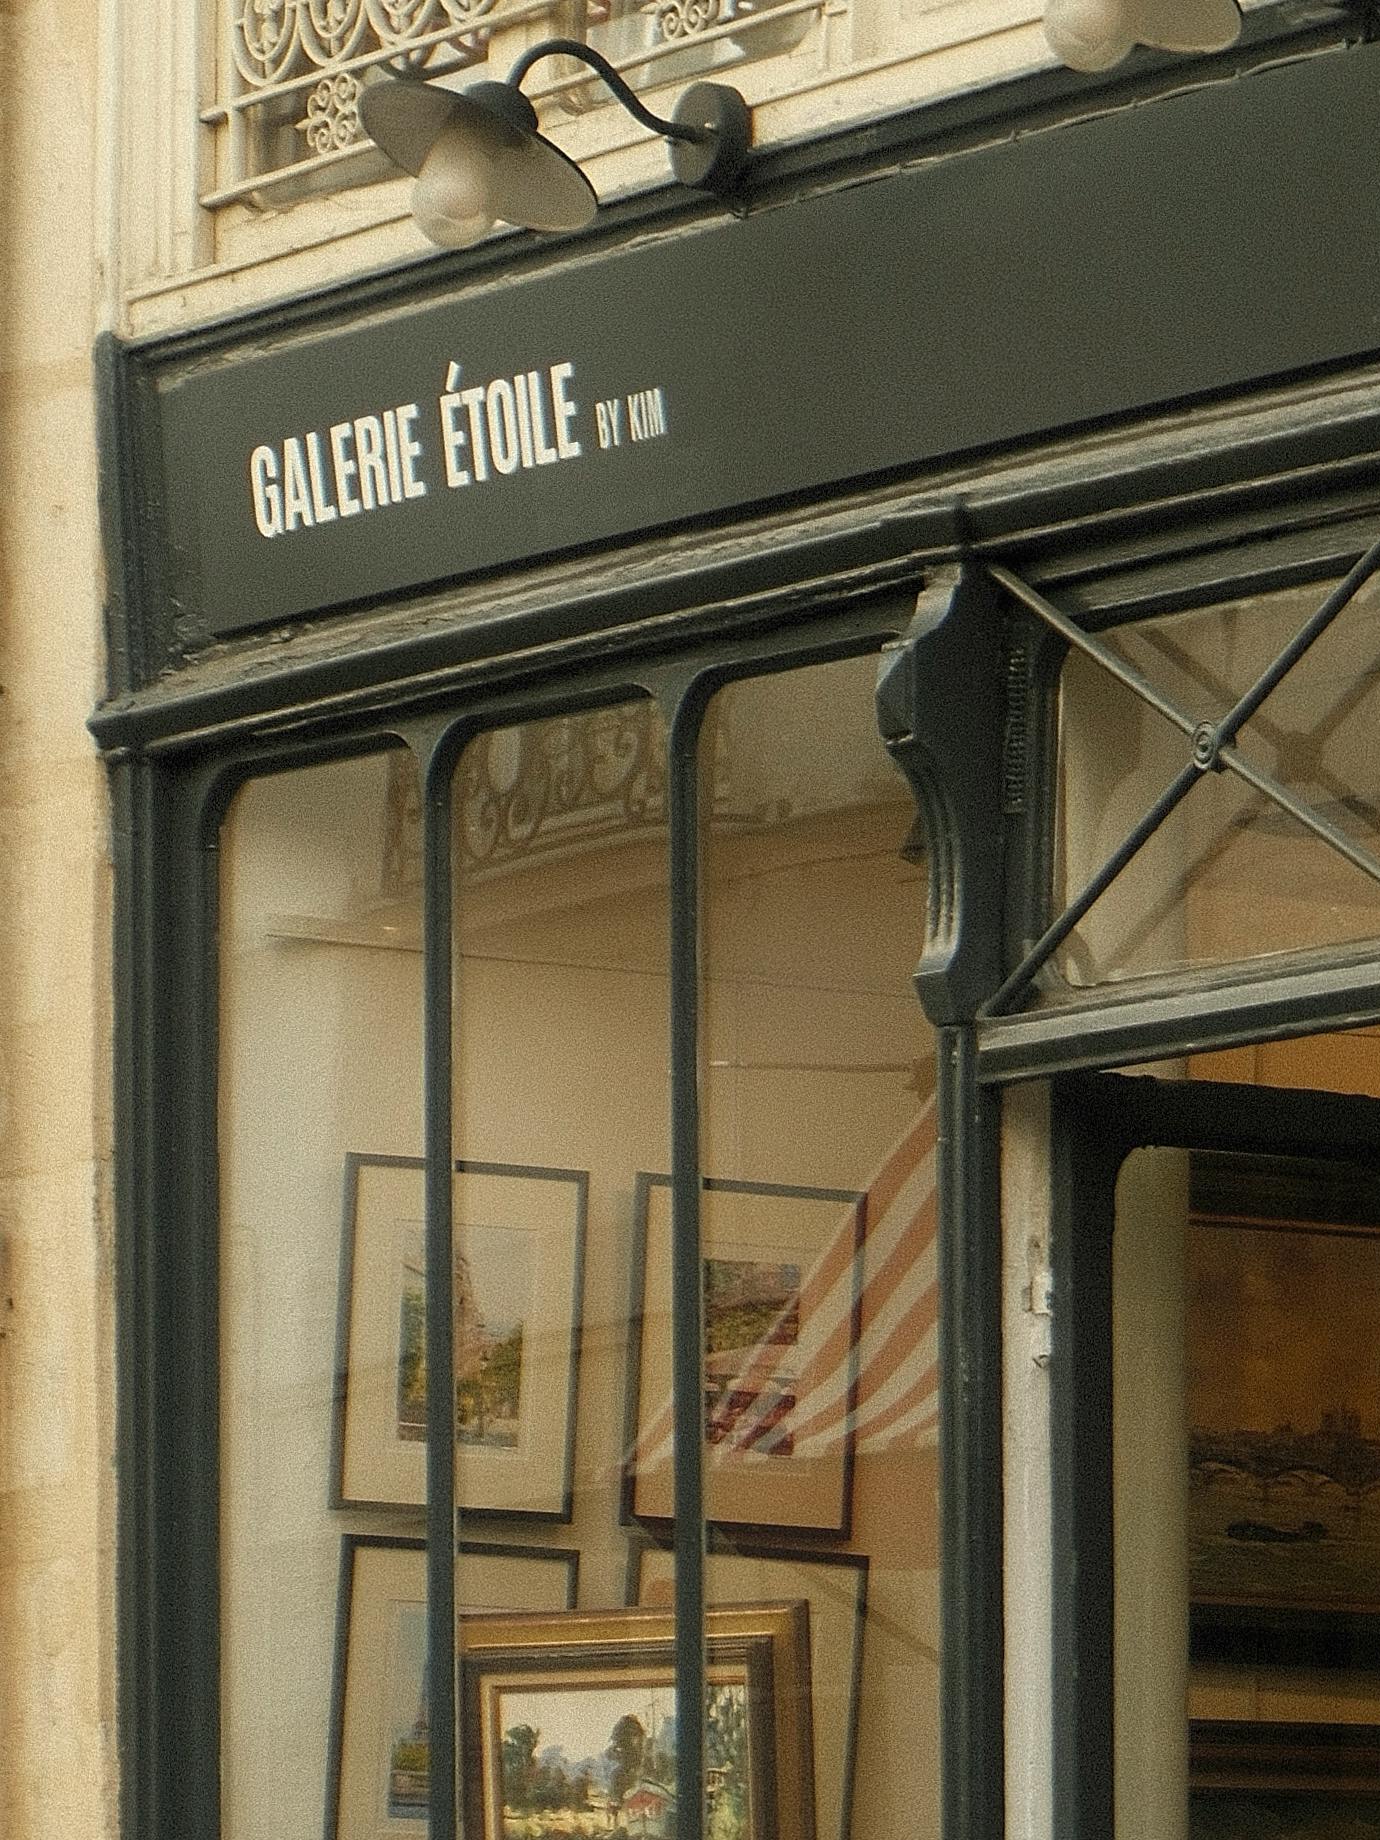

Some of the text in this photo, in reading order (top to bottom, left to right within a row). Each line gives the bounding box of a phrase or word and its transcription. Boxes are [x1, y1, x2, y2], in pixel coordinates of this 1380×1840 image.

[251, 361, 667, 538] GALERIE ÉTOILE BY KIM
